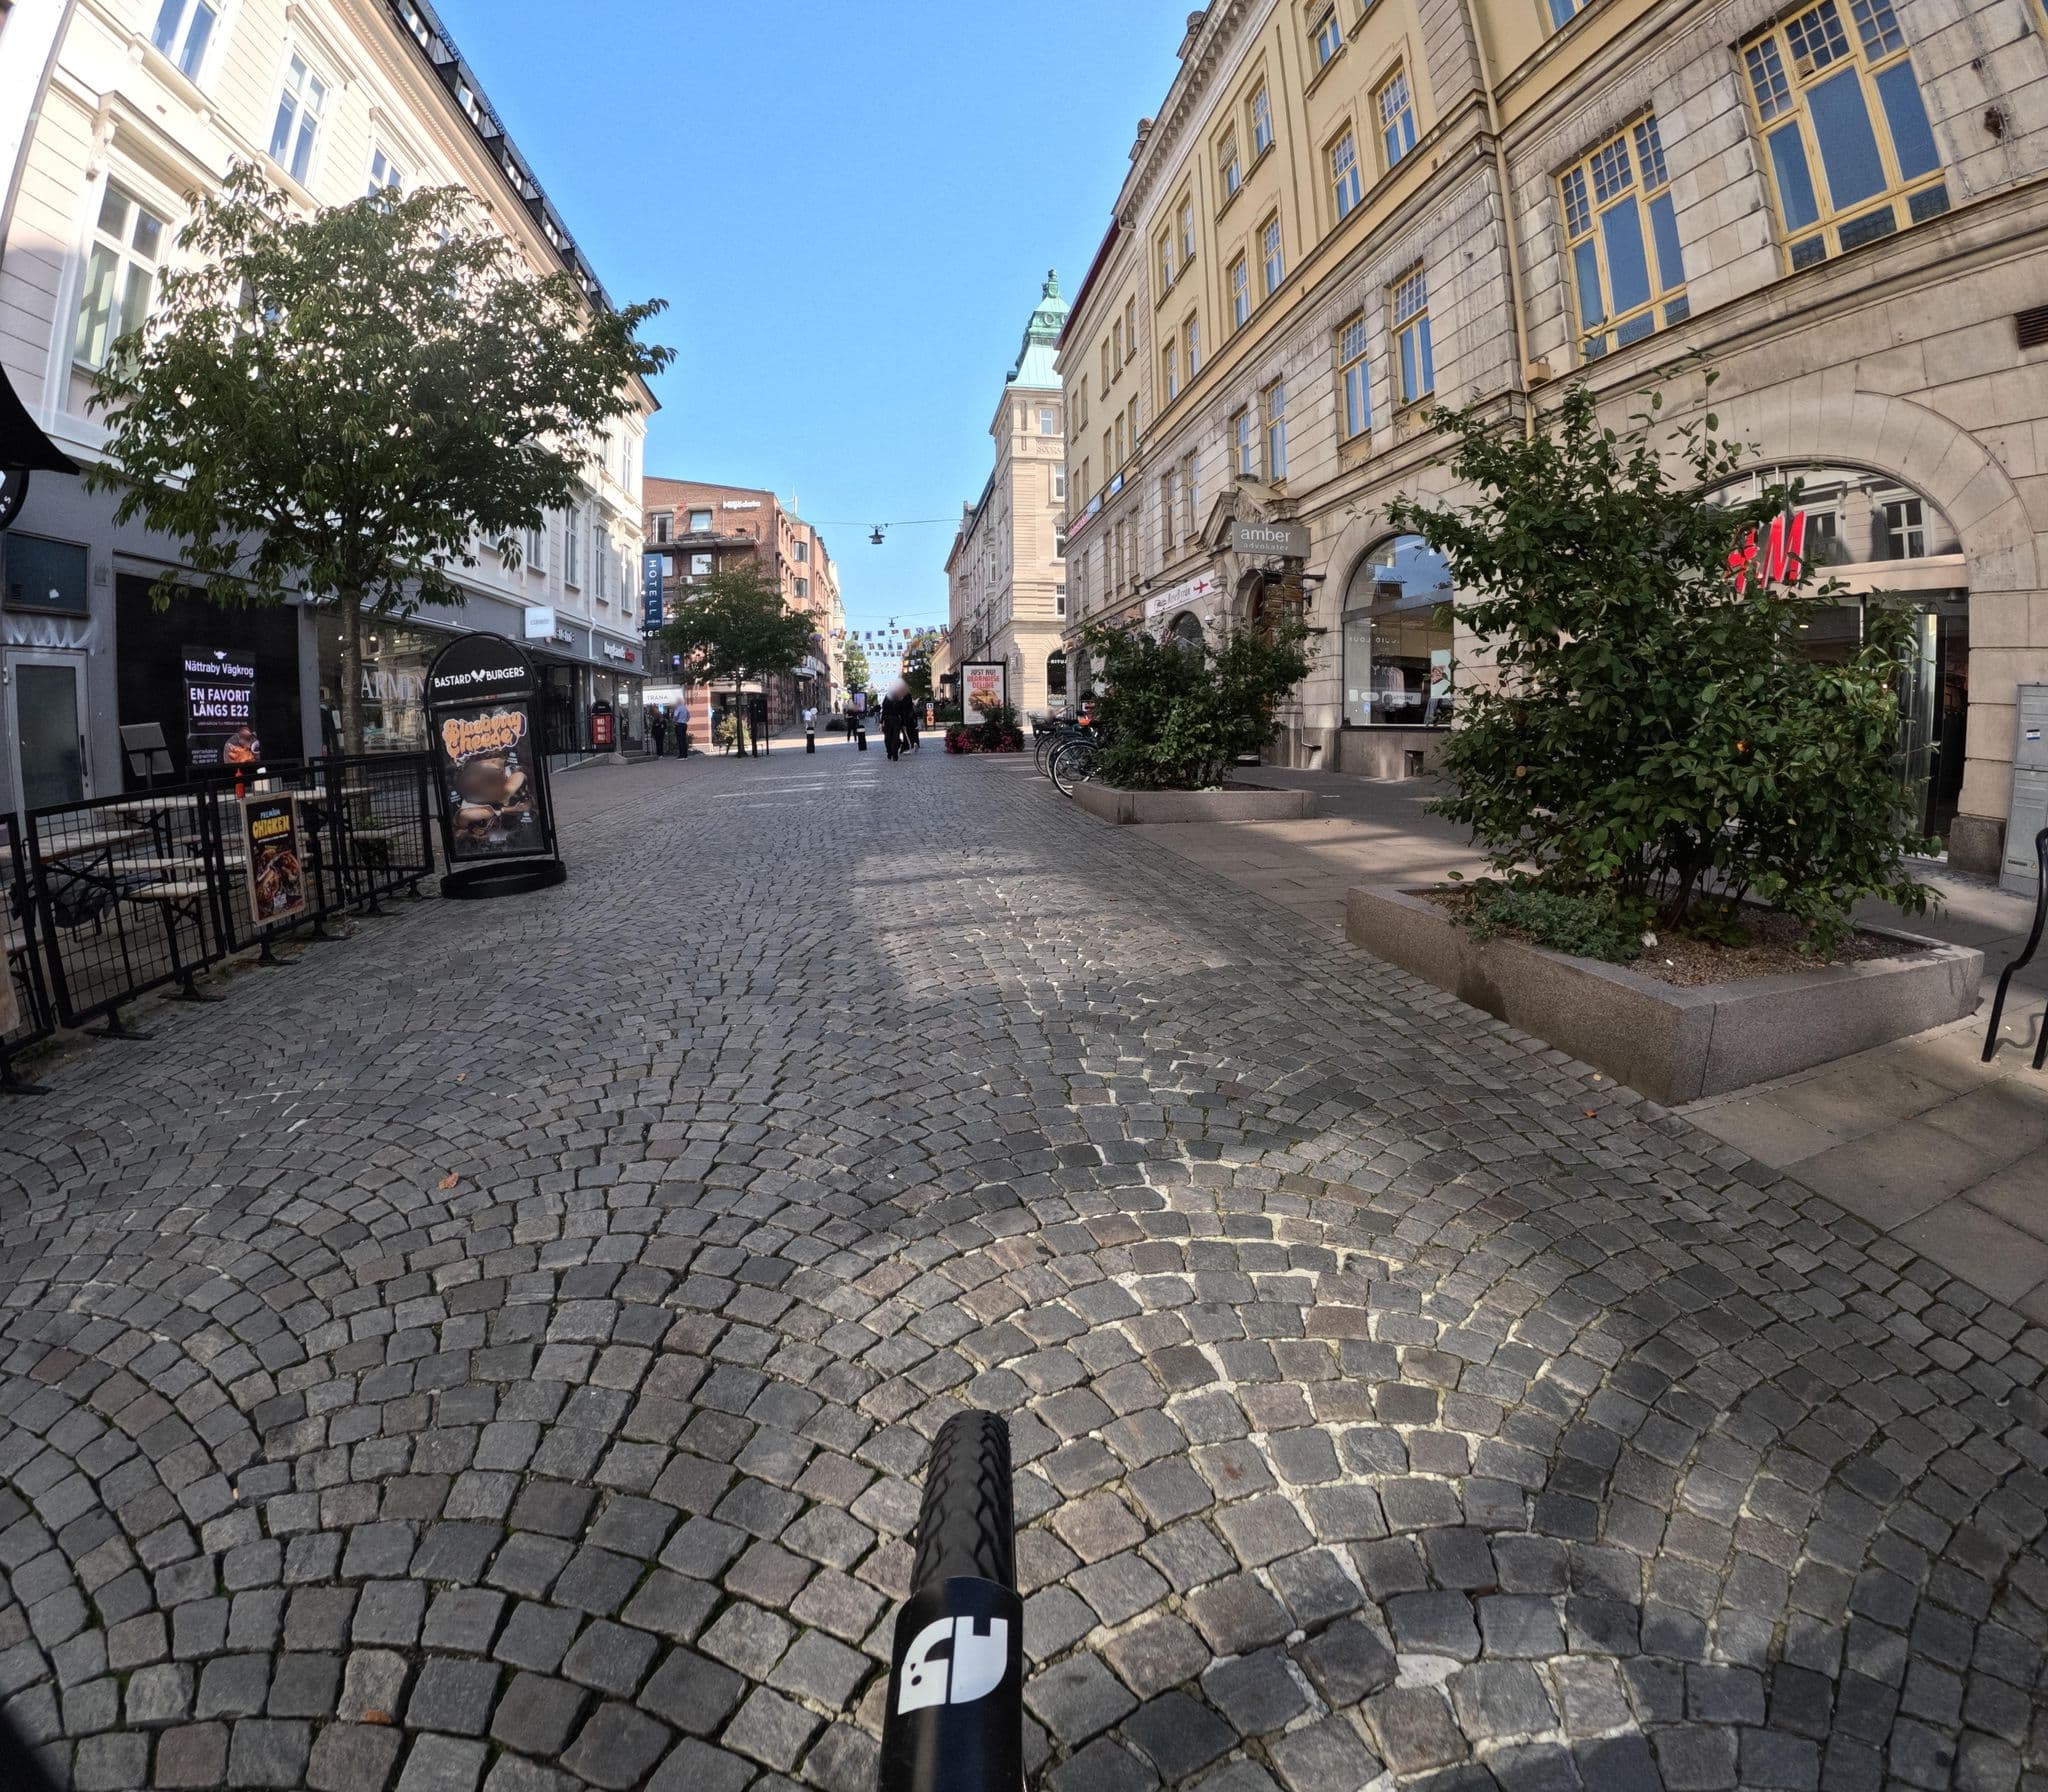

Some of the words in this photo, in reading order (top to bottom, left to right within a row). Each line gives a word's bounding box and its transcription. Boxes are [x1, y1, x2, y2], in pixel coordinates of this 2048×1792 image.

[1240, 527, 1291, 543] amber
[1243, 542, 1289, 552] advokater
[648, 559, 658, 616] HOTELL
[185, 660, 220, 676] Nättraby
[221, 663, 254, 679] Vägkrog
[434, 673, 472, 688] BASTARD
[486, 666, 525, 682] BURGERS
[341, 668, 425, 700] ARMEN
[190, 687, 205, 702] EN
[208, 688, 251, 702] FAVORIT
[231, 704, 249, 717] E22
[252, 815, 290, 840] CHICKEN
